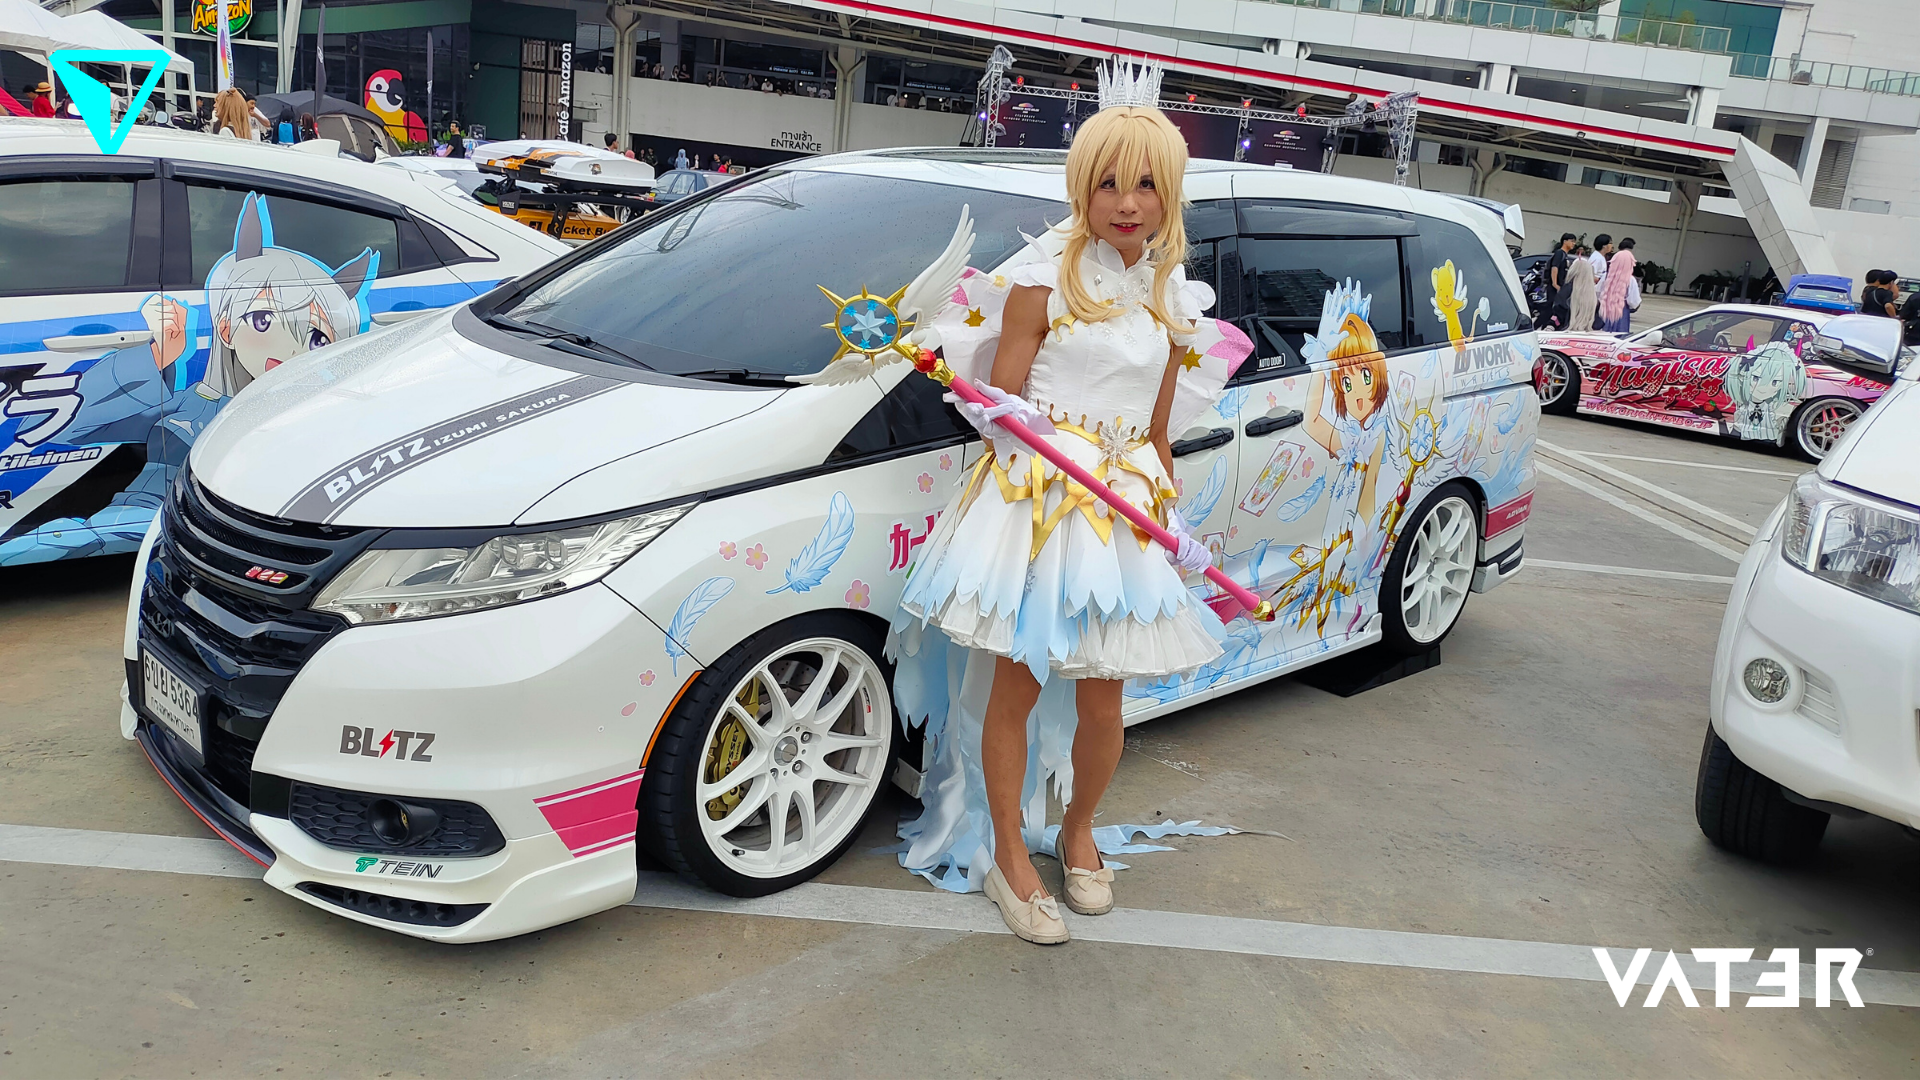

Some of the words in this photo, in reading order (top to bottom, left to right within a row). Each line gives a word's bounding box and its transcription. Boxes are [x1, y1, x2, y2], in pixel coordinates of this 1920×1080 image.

[194, 0, 251, 30] Amzon
[559, 43, 571, 107] Amazon
[771, 138, 822, 152] ENTRANCE
[781, 130, 813, 142] ทางเข้า
[1259, 358, 1270, 368] AUTO
[1271, 355, 1282, 366] DOOR
[1473, 341, 1513, 370] WORK
[1461, 367, 1510, 387] WHEELS
[1589, 353, 1730, 397] Nagisa
[434, 422, 488, 447] IZUMI
[495, 392, 571, 423] SAKURA
[1505, 504, 1528, 520] ADVAN
[170, 674, 199, 724] 5364
[378, 859, 443, 879] TEIN
